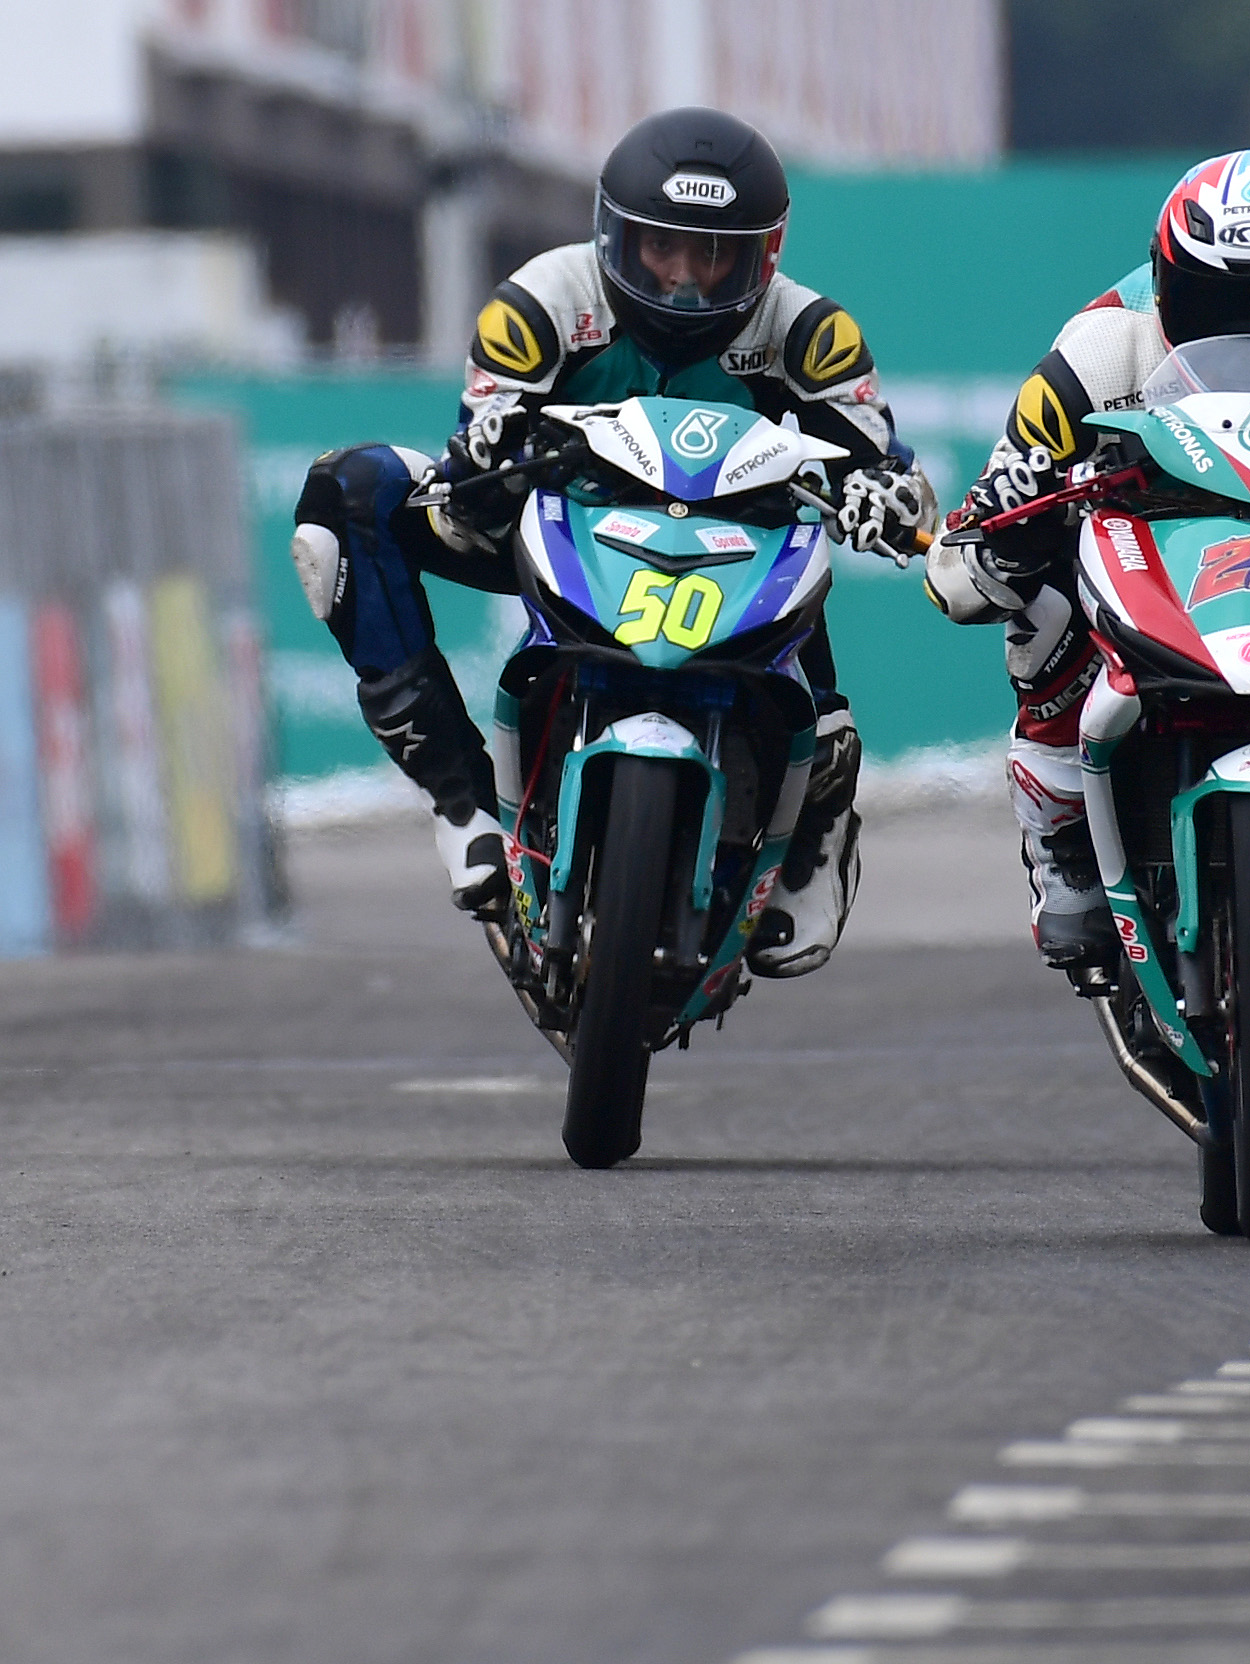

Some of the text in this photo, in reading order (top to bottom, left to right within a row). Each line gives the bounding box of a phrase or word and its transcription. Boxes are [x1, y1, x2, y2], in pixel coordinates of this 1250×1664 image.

[675, 180, 725, 200] SHOEI
[608, 419, 657, 477] PETRONAS
[725, 442, 789, 485] PETRONAS
[1107, 529, 1149, 573] YAMAHA
[614, 569, 724, 650] 50
[1043, 630, 1074, 674] TAICHI
